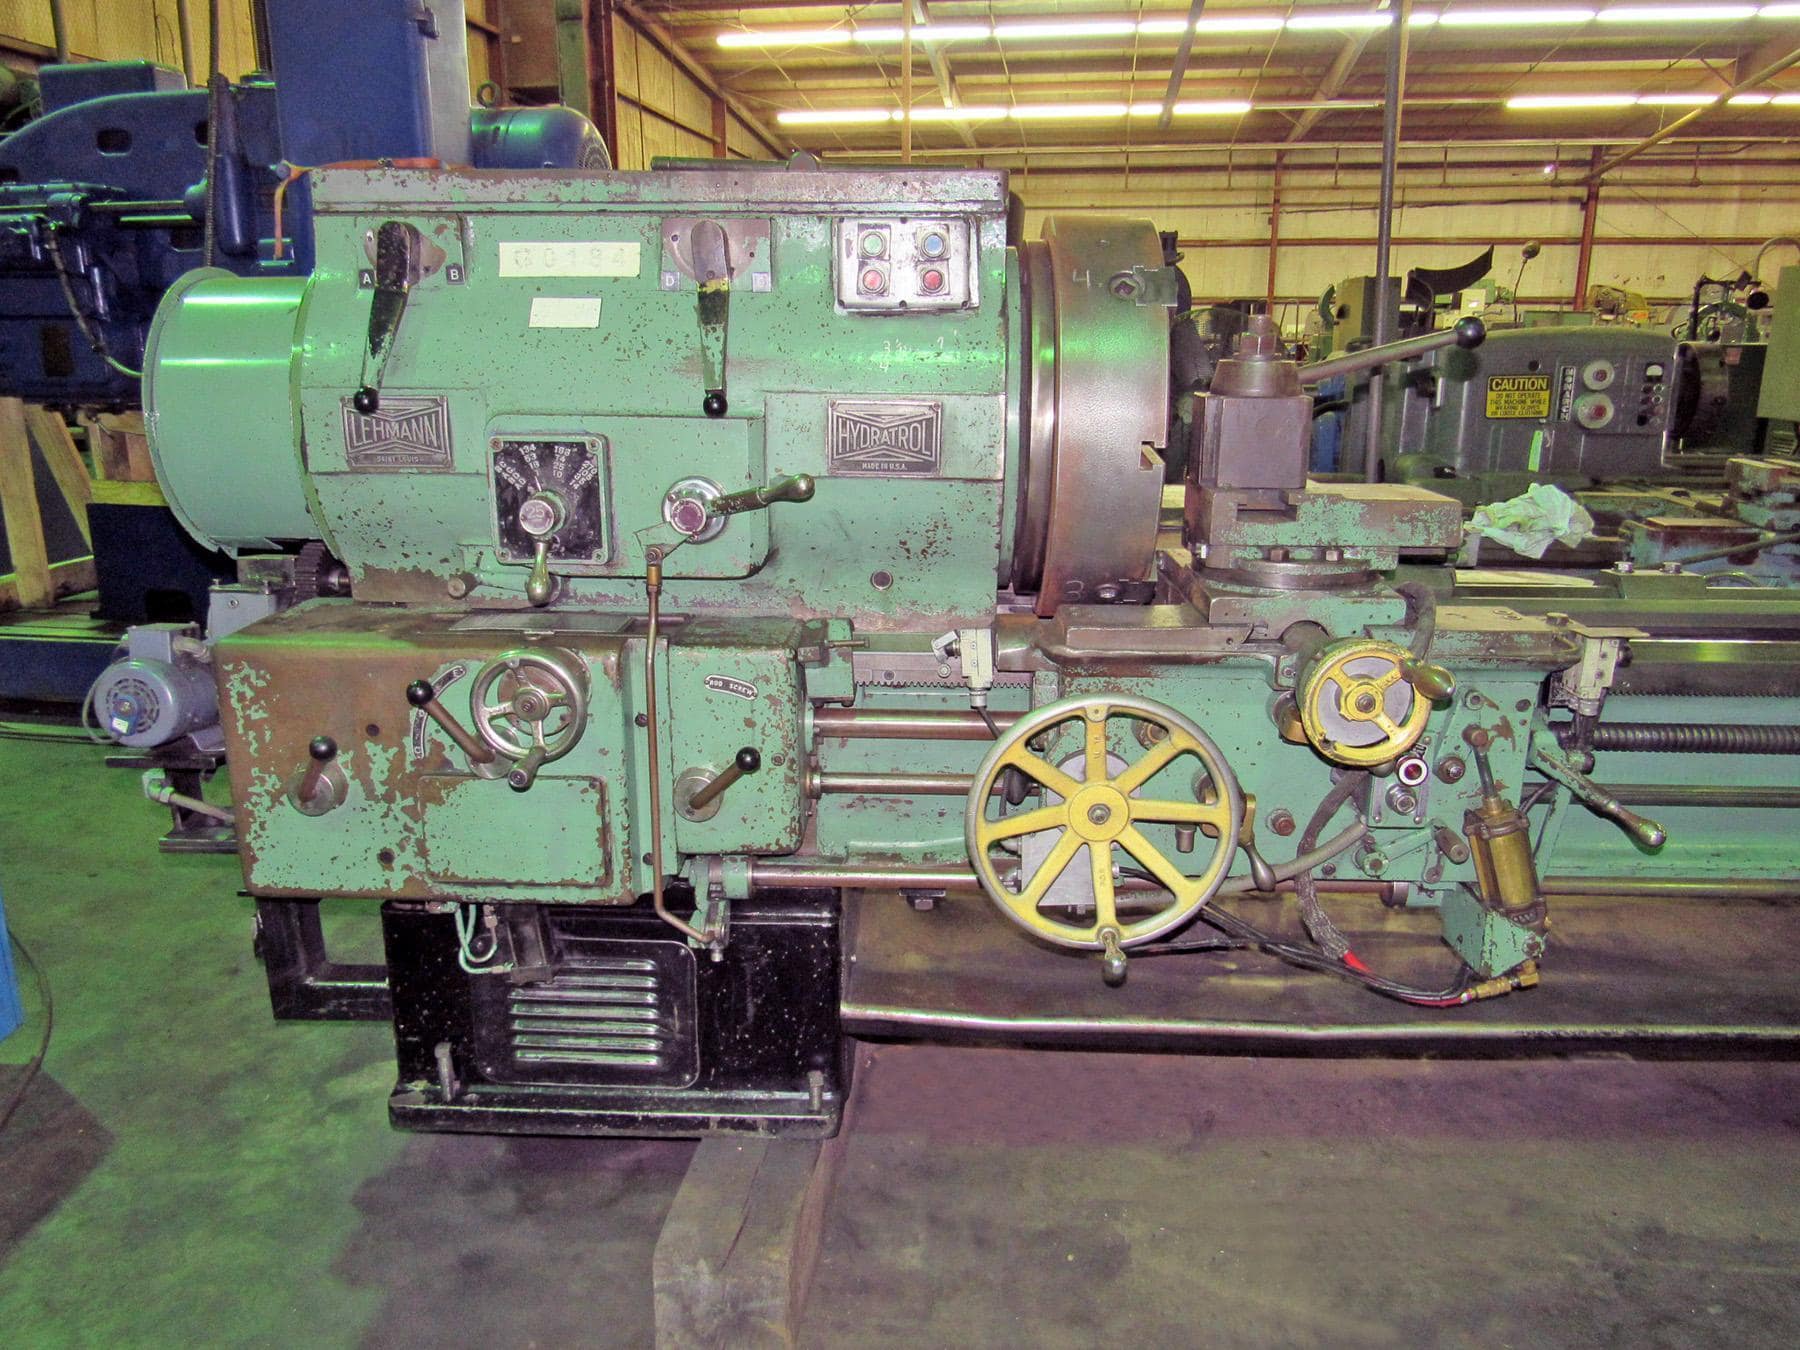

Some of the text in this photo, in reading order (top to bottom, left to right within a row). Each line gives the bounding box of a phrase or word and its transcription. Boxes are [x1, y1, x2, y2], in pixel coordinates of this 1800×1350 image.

[363, 273, 371, 284] A
[450, 269, 459, 280] B
[665, 275, 675, 287] D
[1492, 378, 1548, 391] CAUTION
[1560, 367, 1574, 421] MONARCH
[350, 412, 438, 448] LEHMANN
[838, 417, 932, 456] HYDRATROL
[519, 443, 537, 455] 134
[582, 460, 597, 475] 270
[862, 462, 879, 470] MADE
[880, 462, 888, 470] IN
